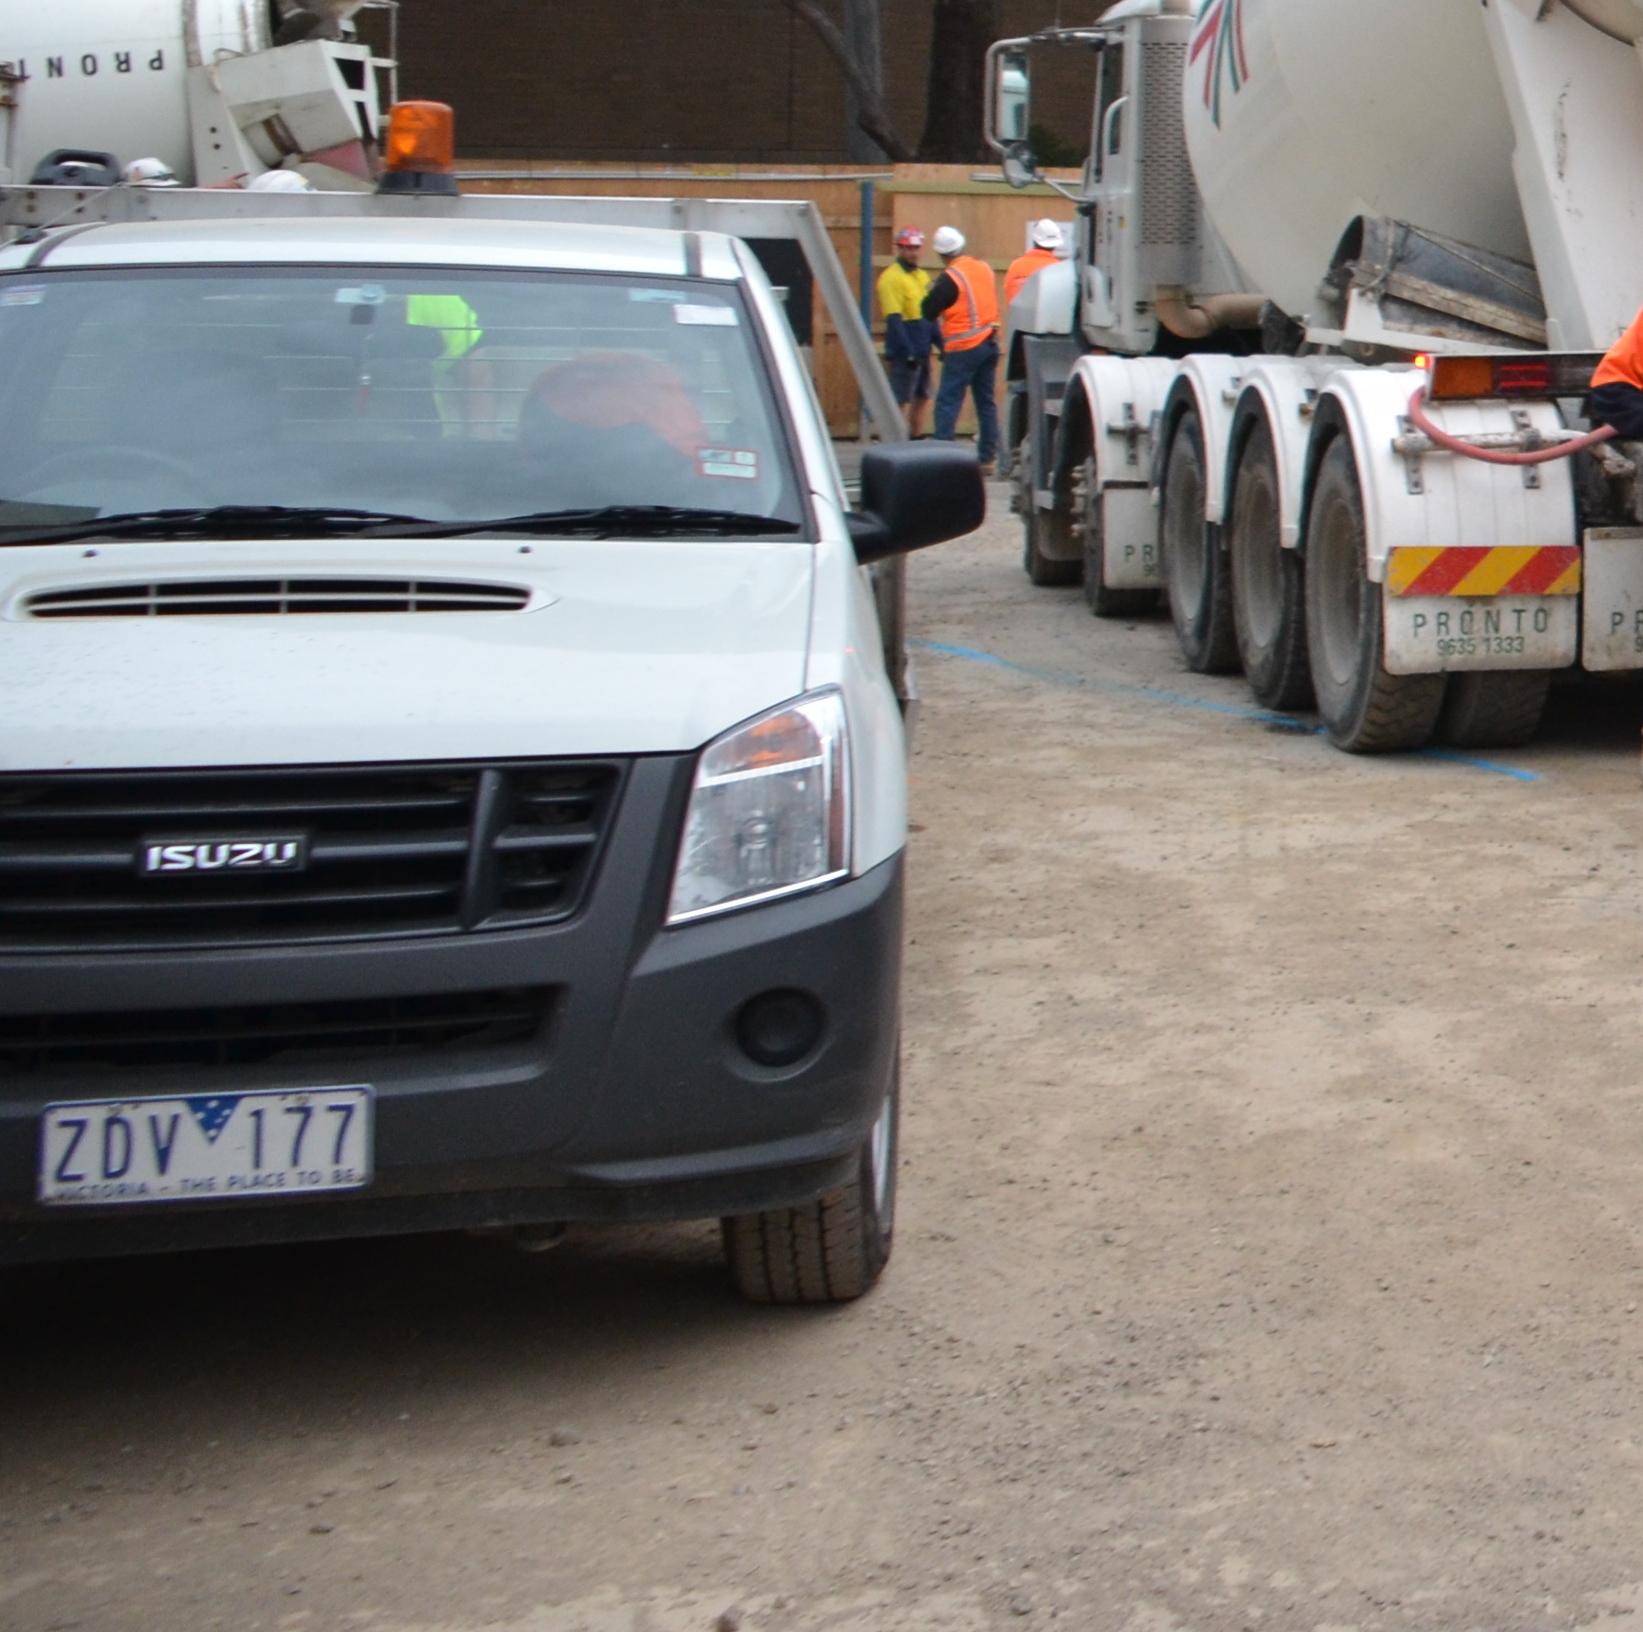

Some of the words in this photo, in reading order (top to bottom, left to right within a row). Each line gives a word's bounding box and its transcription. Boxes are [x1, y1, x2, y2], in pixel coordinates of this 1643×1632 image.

[18, 49, 164, 82] PRONT
[1413, 607, 1548, 638] PRONTO
[1437, 638, 1477, 656] 9635
[1482, 636, 1525, 654] 1333
[147, 842, 298, 871] ISUZU
[54, 1113, 183, 1183] ZDV
[249, 1103, 356, 1170] 177
[55, 1181, 149, 1201] VICTORIA
[181, 1177, 217, 1192] THE
[229, 1172, 286, 1189] PLACE
[298, 1170, 321, 1185] TO
[332, 1168, 354, 1184] BE
